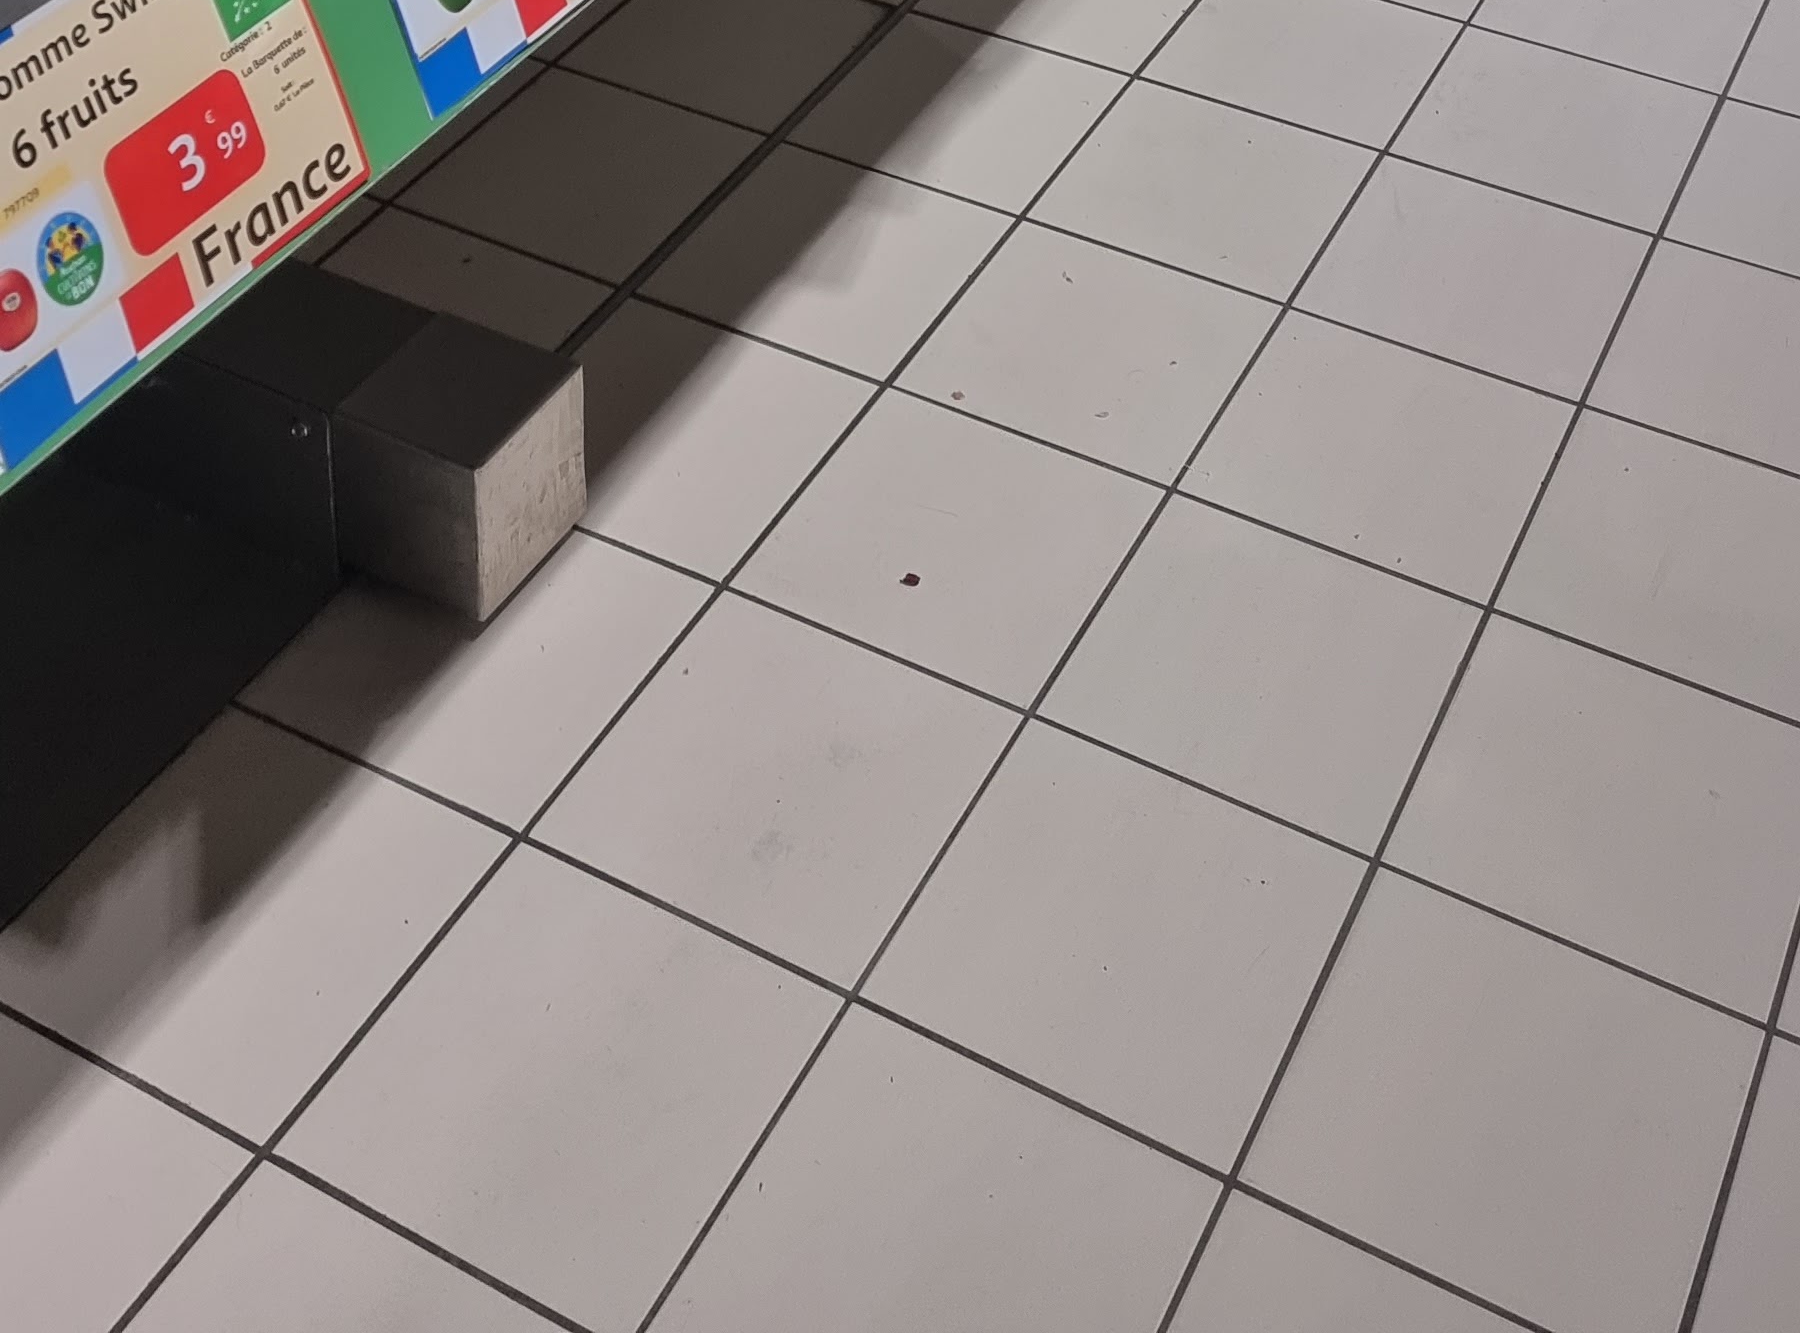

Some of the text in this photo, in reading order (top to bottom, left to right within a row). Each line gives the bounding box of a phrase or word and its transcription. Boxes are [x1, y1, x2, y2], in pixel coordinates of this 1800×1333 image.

[264, 20, 273, 33] 2
[252, 36, 290, 72] Barquette
[273, 46, 306, 77] 6 unités
[11, 67, 139, 169] 6 fruits
[167, 121, 248, 192] 3 99
[191, 143, 351, 288] France
